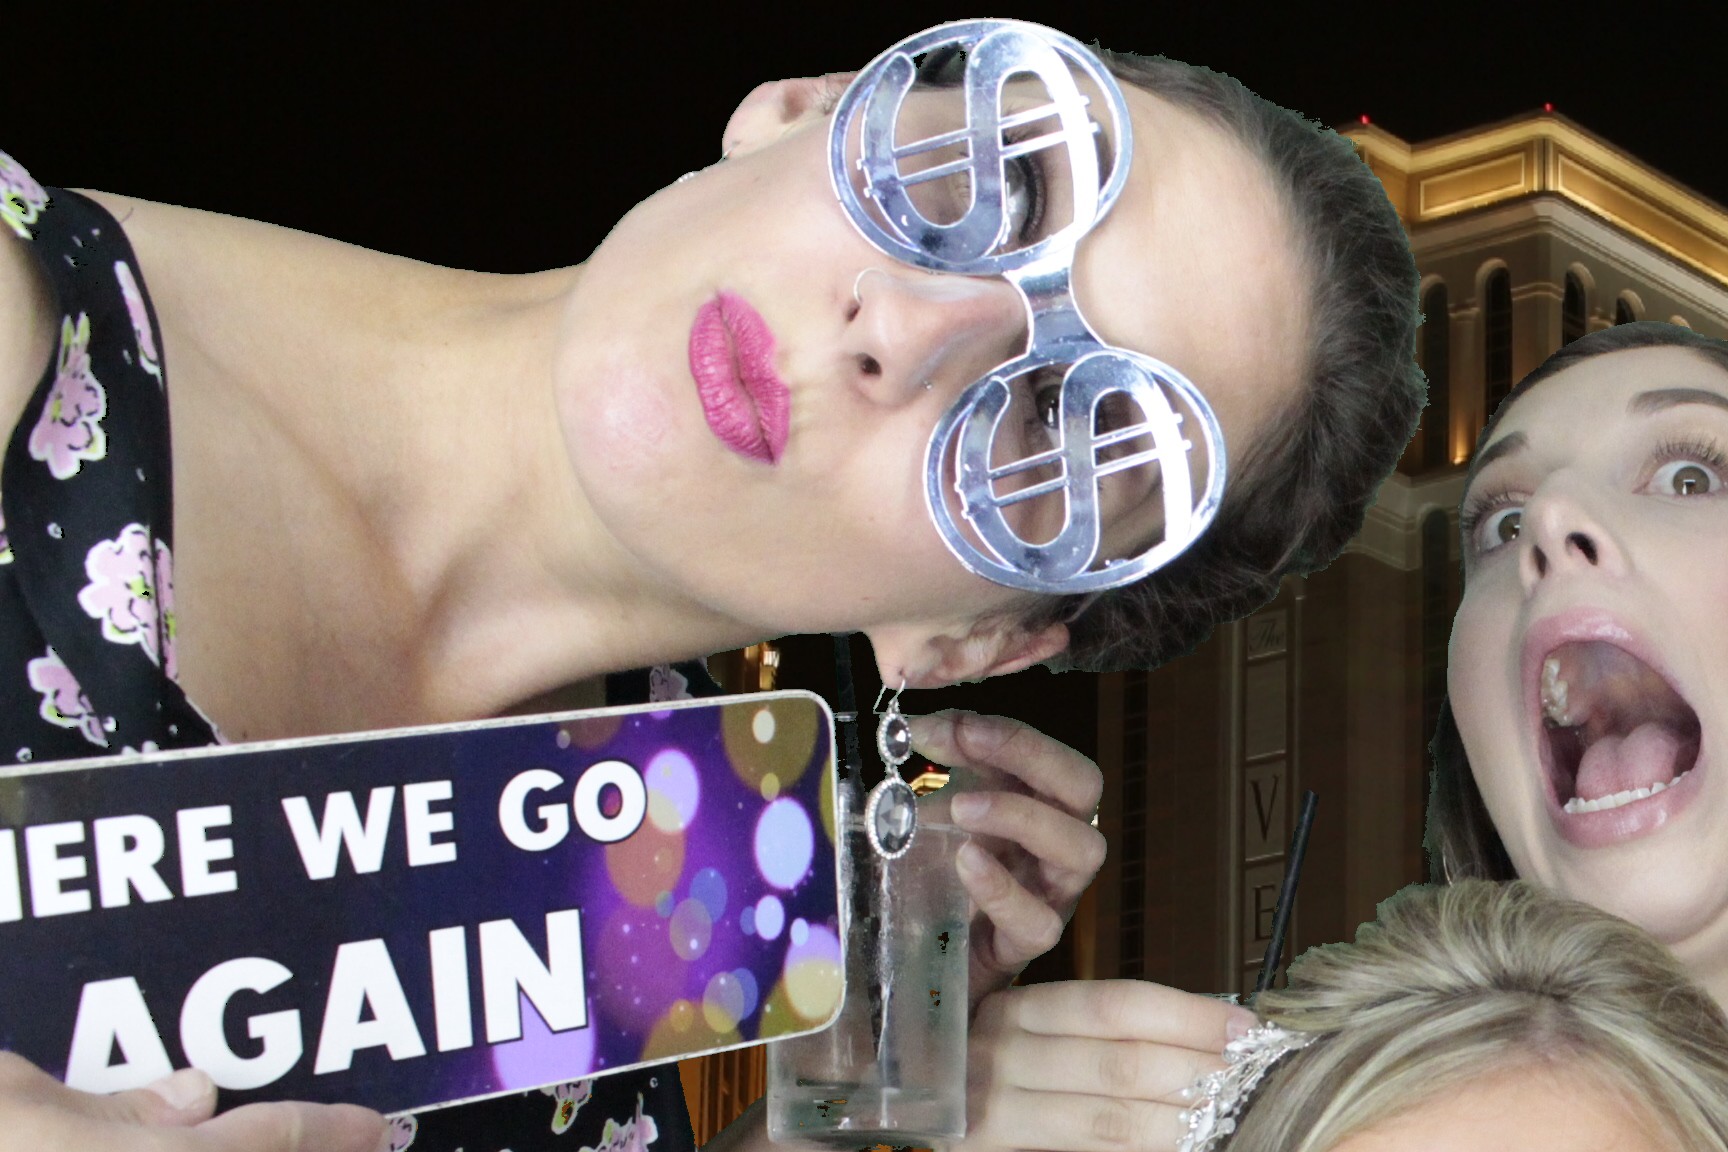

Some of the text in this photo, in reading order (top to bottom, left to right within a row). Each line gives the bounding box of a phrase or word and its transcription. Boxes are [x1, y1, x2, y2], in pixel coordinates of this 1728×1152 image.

[281, 779, 458, 881] WE
[498, 759, 649, 853] GO
[64, 908, 589, 1095] AGAIN
